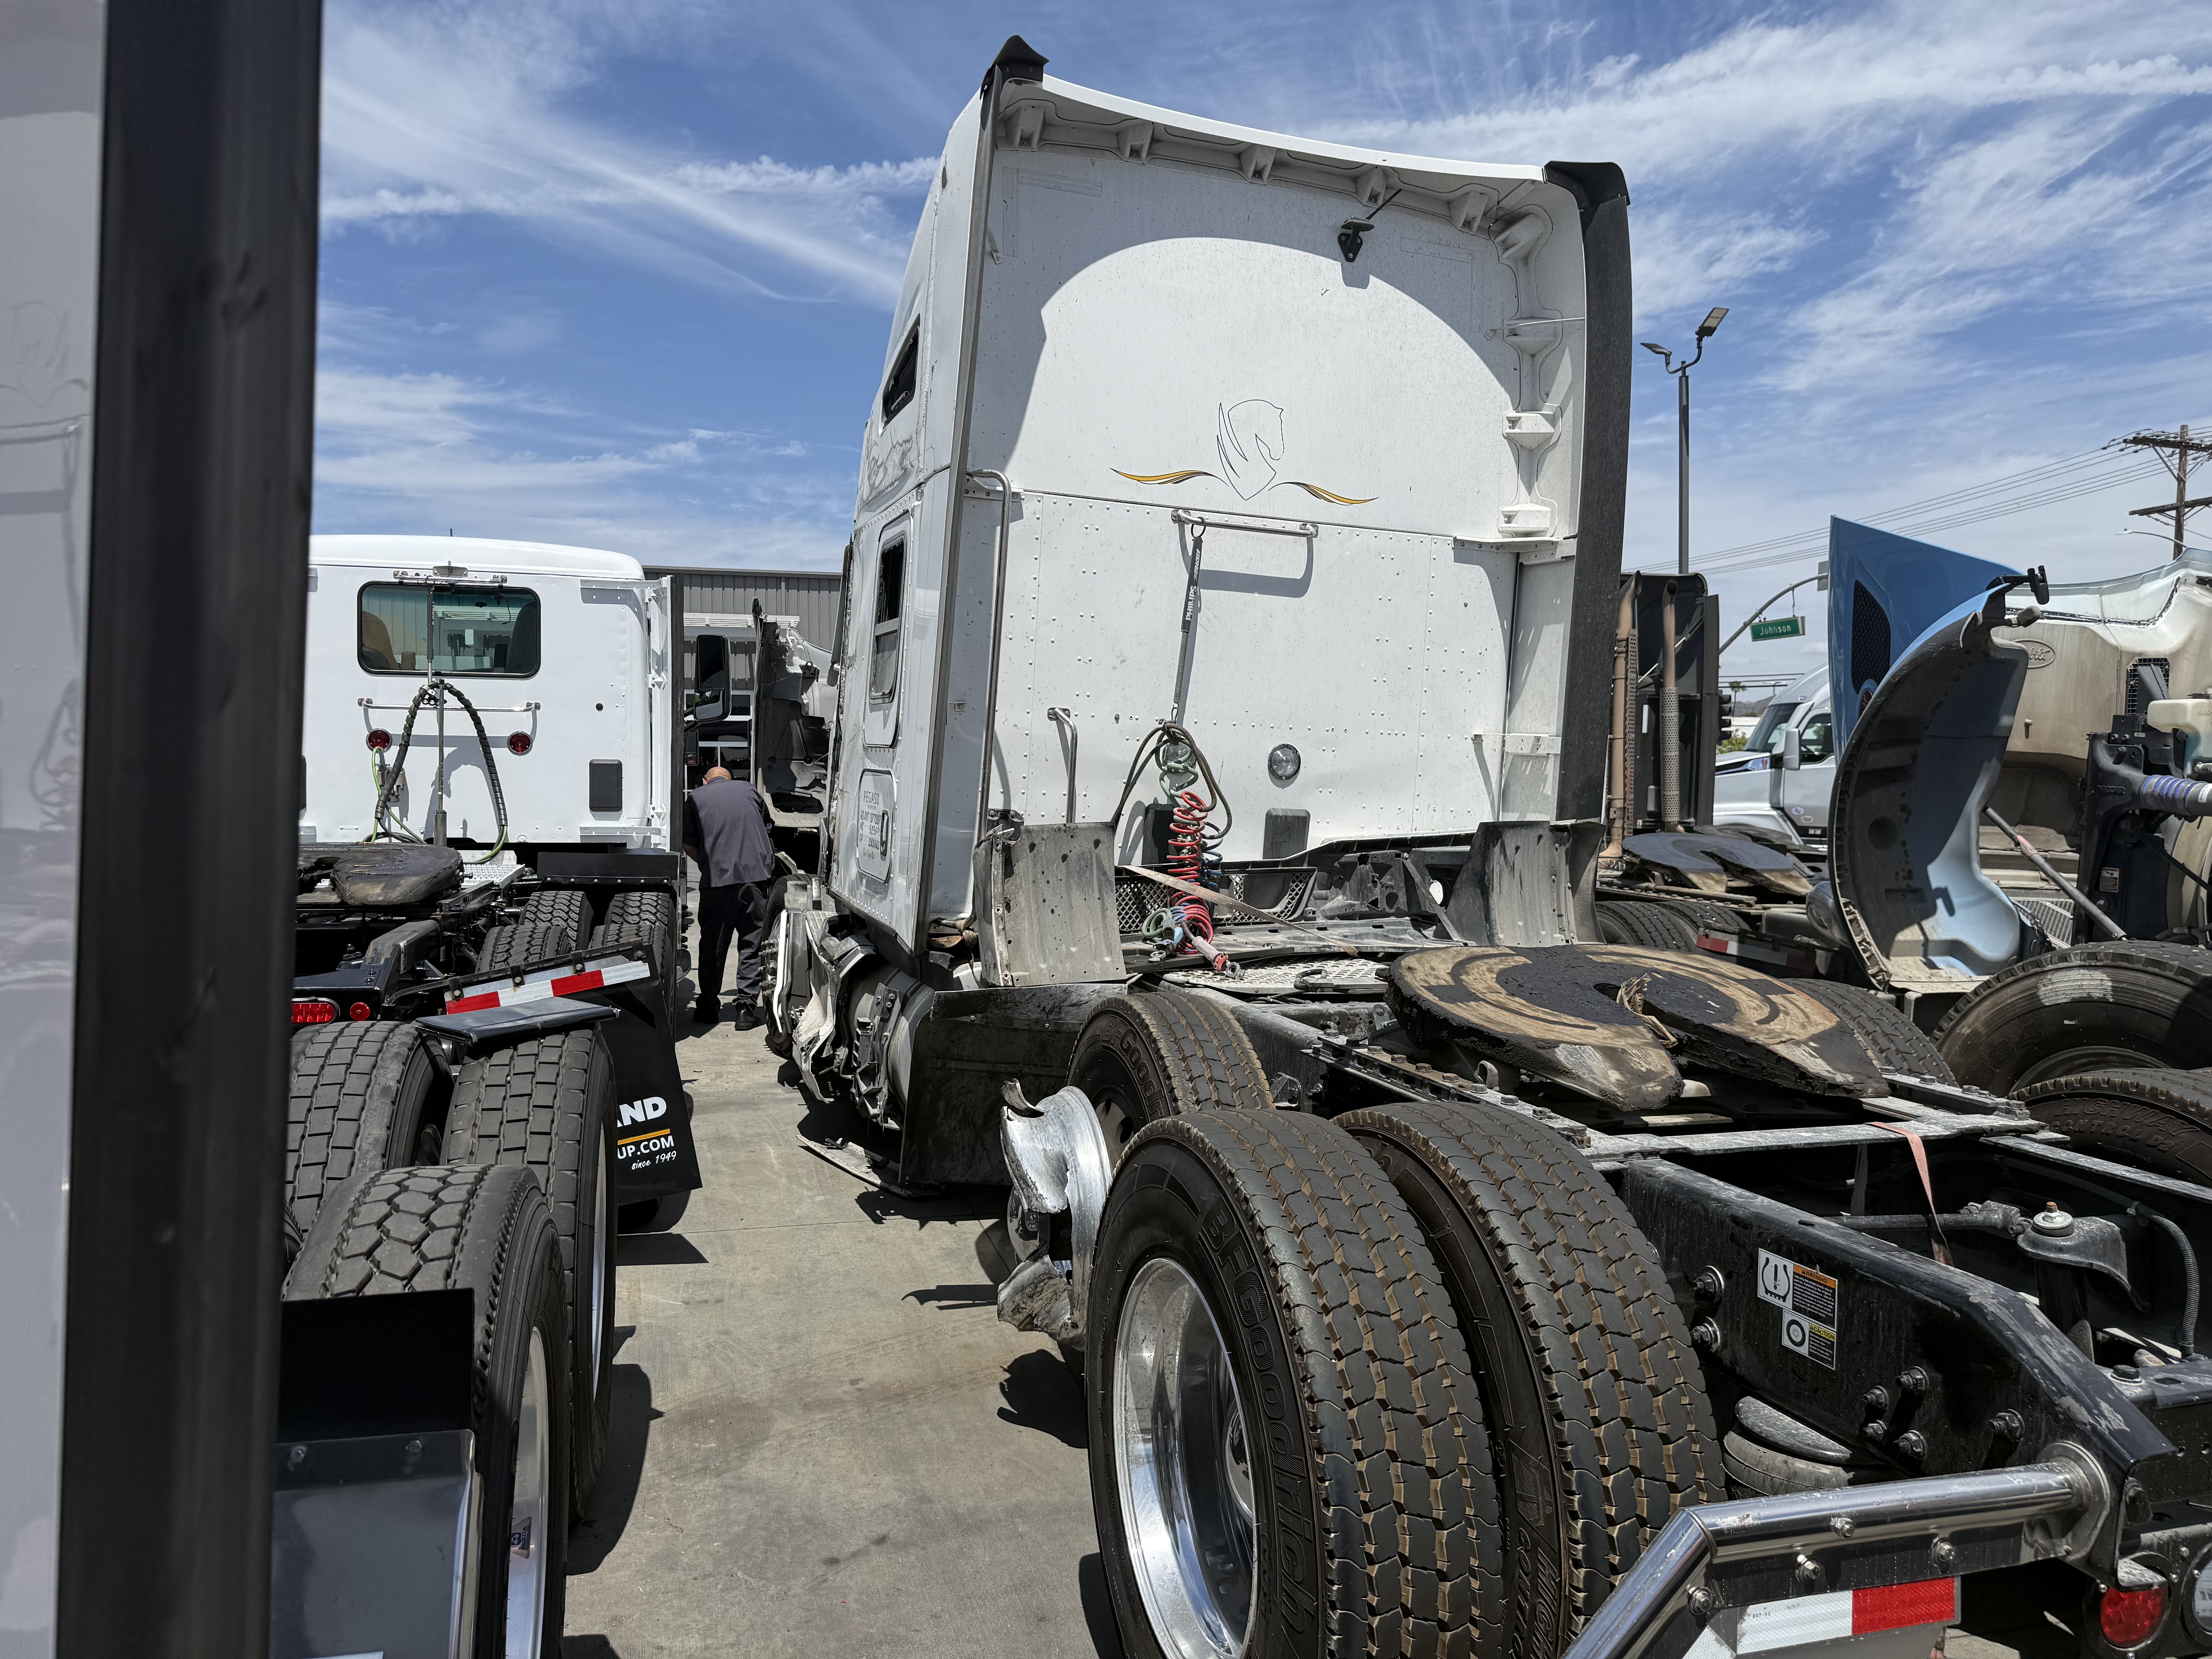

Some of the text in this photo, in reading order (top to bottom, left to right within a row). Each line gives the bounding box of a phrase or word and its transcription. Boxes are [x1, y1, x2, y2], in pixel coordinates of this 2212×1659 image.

[1760, 625, 1791, 635] Johnson
[864, 790, 879, 805] PEGASO
[2054, 1097, 2201, 1135] HIGHWAY
[2145, 1134, 2176, 1152] D2
[631, 1150, 677, 1170] since 1949
[1805, 1270, 1827, 1283] WARNING
[1814, 1327, 1835, 1340] CAUTION
[1200, 1195, 1317, 1634] BFGoodrich
[1509, 1527, 1531, 1659] CONTRO
